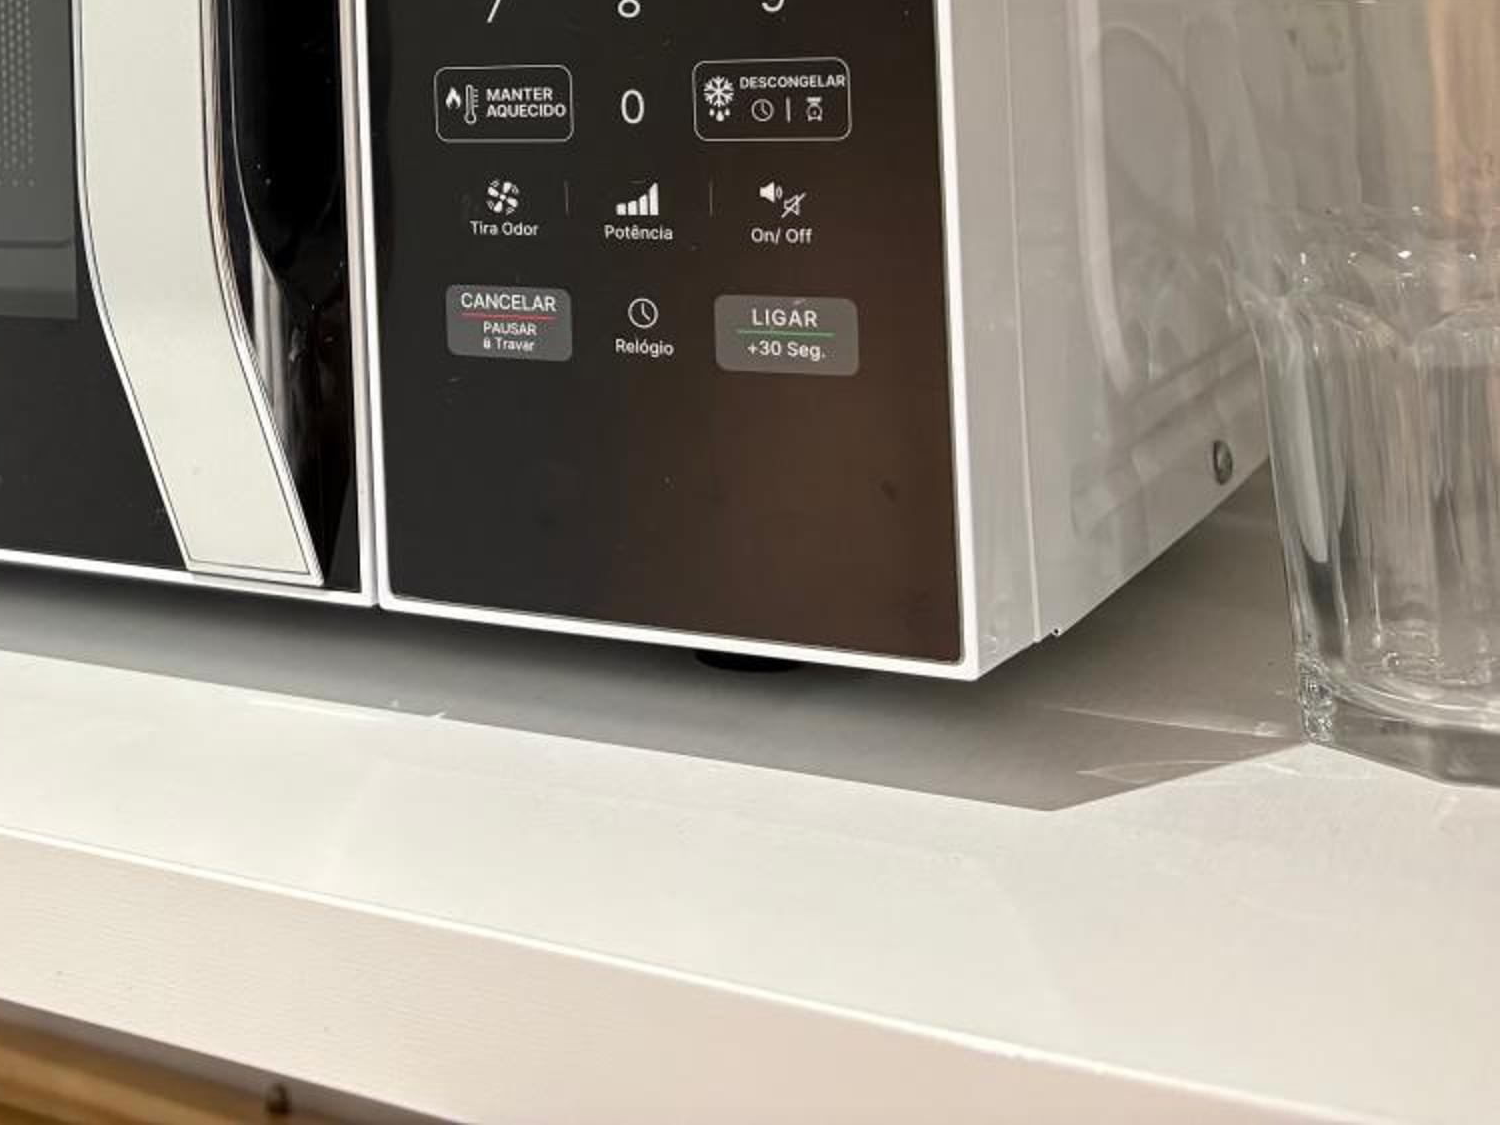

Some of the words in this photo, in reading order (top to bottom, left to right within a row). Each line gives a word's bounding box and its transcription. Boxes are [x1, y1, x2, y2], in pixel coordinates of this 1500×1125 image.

[739, 74, 846, 90] DESCONGELAR
[486, 86, 554, 102] MANTER
[486, 103, 567, 119] AQUECIDO
[620, 89, 645, 124] 0
[469, 220, 499, 236] Tira
[501, 220, 539, 236] Odor
[604, 224, 674, 241] Potência
[750, 227, 782, 245] On/
[785, 228, 813, 244] Off
[460, 292, 557, 312] CANCELAR
[751, 308, 818, 328] LIGAR
[483, 320, 537, 336] PAUSAR
[494, 336, 535, 352] Travar
[615, 338, 675, 358] Relógio
[747, 340, 782, 356] +30
[786, 341, 826, 361] Seg.
